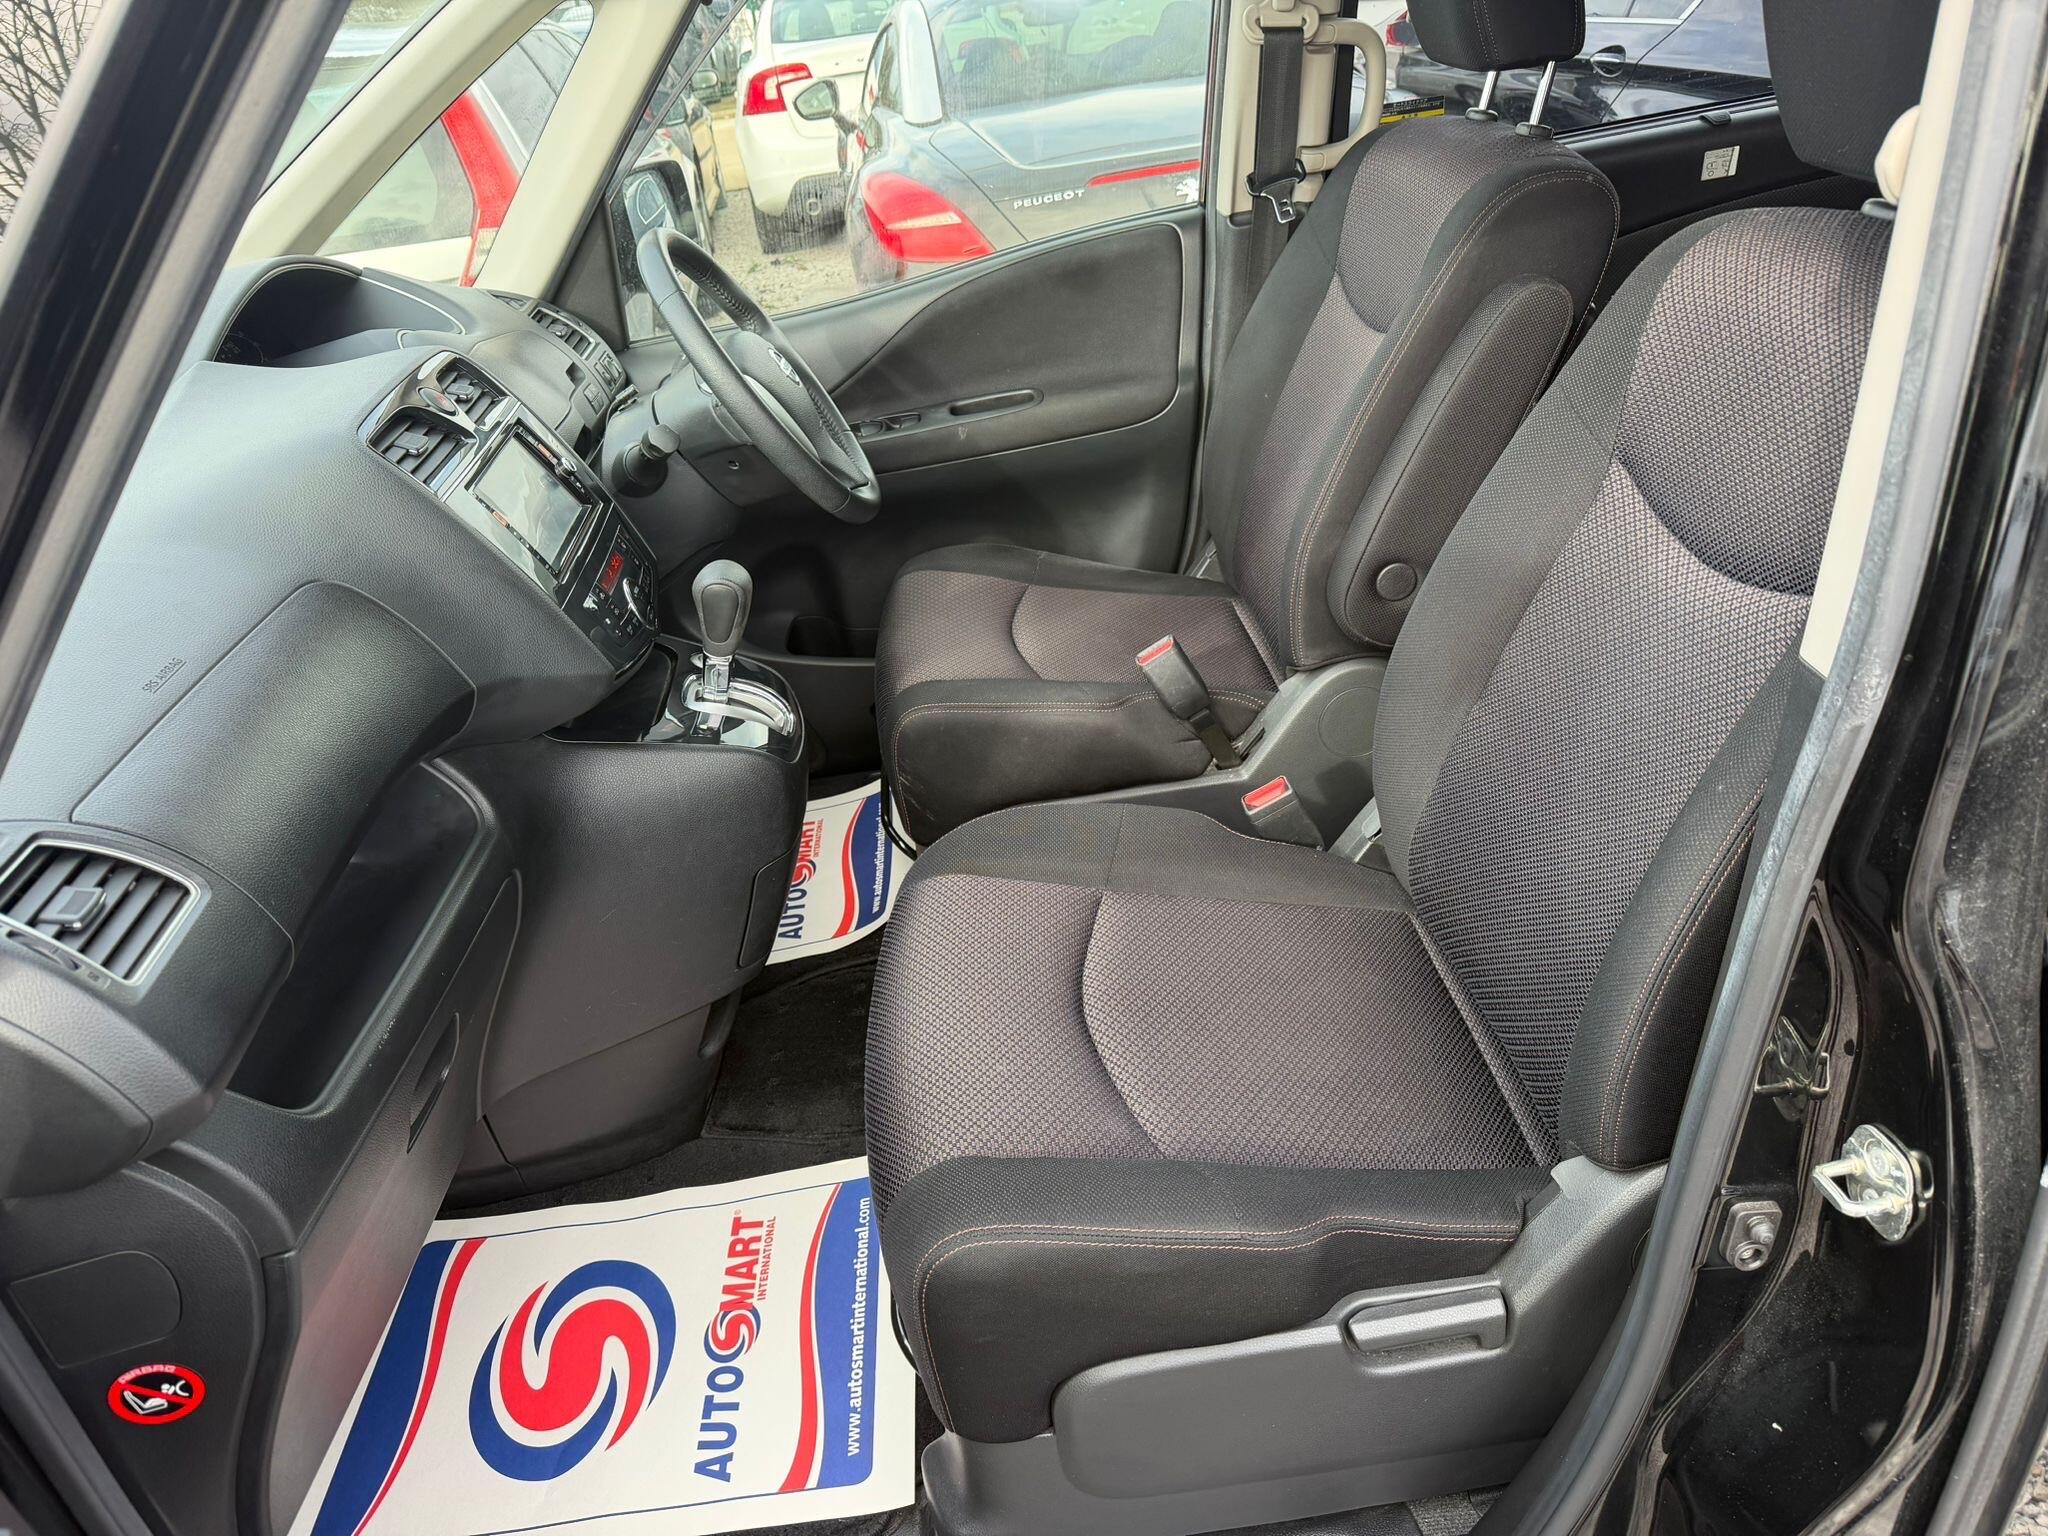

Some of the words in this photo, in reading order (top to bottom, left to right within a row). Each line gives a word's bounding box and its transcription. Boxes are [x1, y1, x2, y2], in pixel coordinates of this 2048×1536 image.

[1013, 188, 1085, 210] PEUGEOT
[142, 679, 160, 692] SRS
[155, 657, 183, 681] AIRBAG
[757, 1216, 776, 1301] INTERNATIONAL
[847, 1196, 871, 1457] www.autosmartinternational.com
